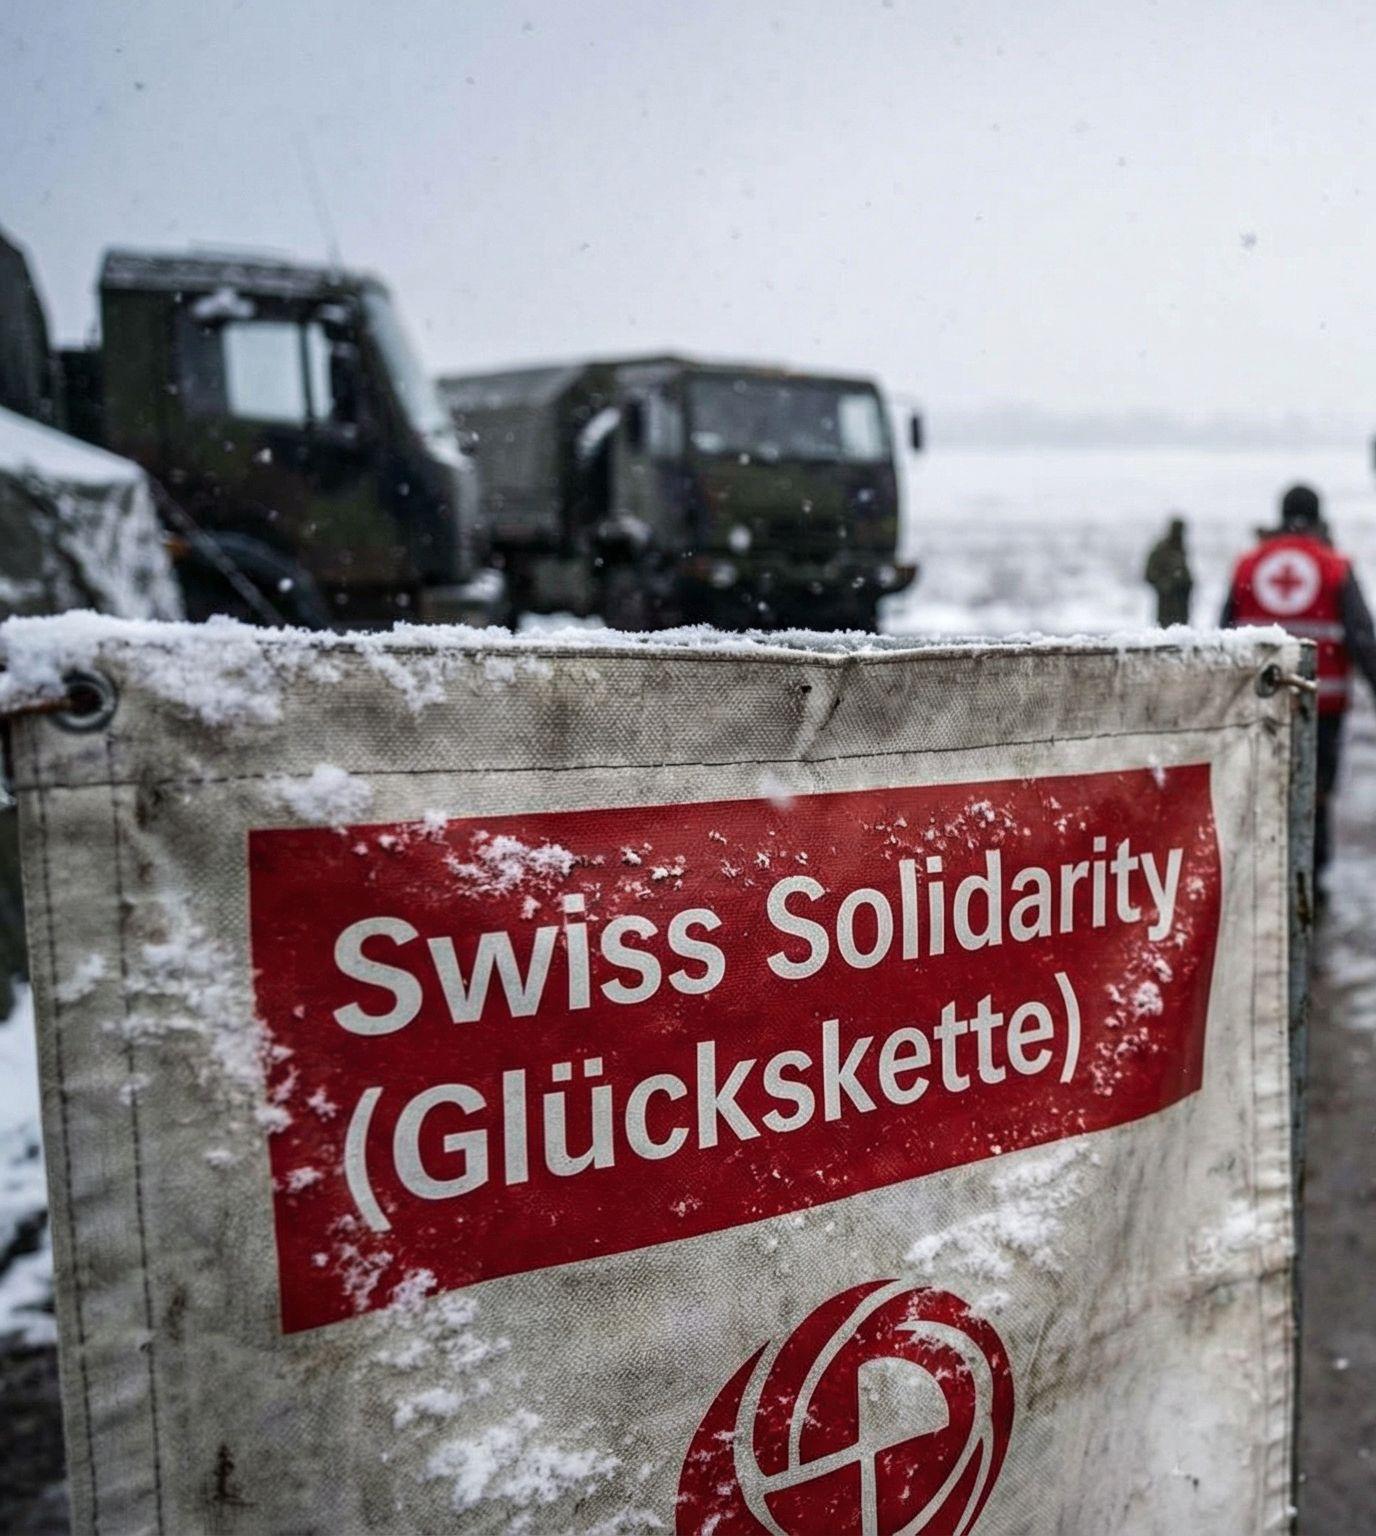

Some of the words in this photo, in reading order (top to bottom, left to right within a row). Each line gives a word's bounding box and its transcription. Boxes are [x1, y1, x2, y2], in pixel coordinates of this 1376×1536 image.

[332, 892, 727, 1036] Swiss
[765, 836, 1185, 981] Solidarity
[342, 971, 1082, 1233] (Glückskette)
